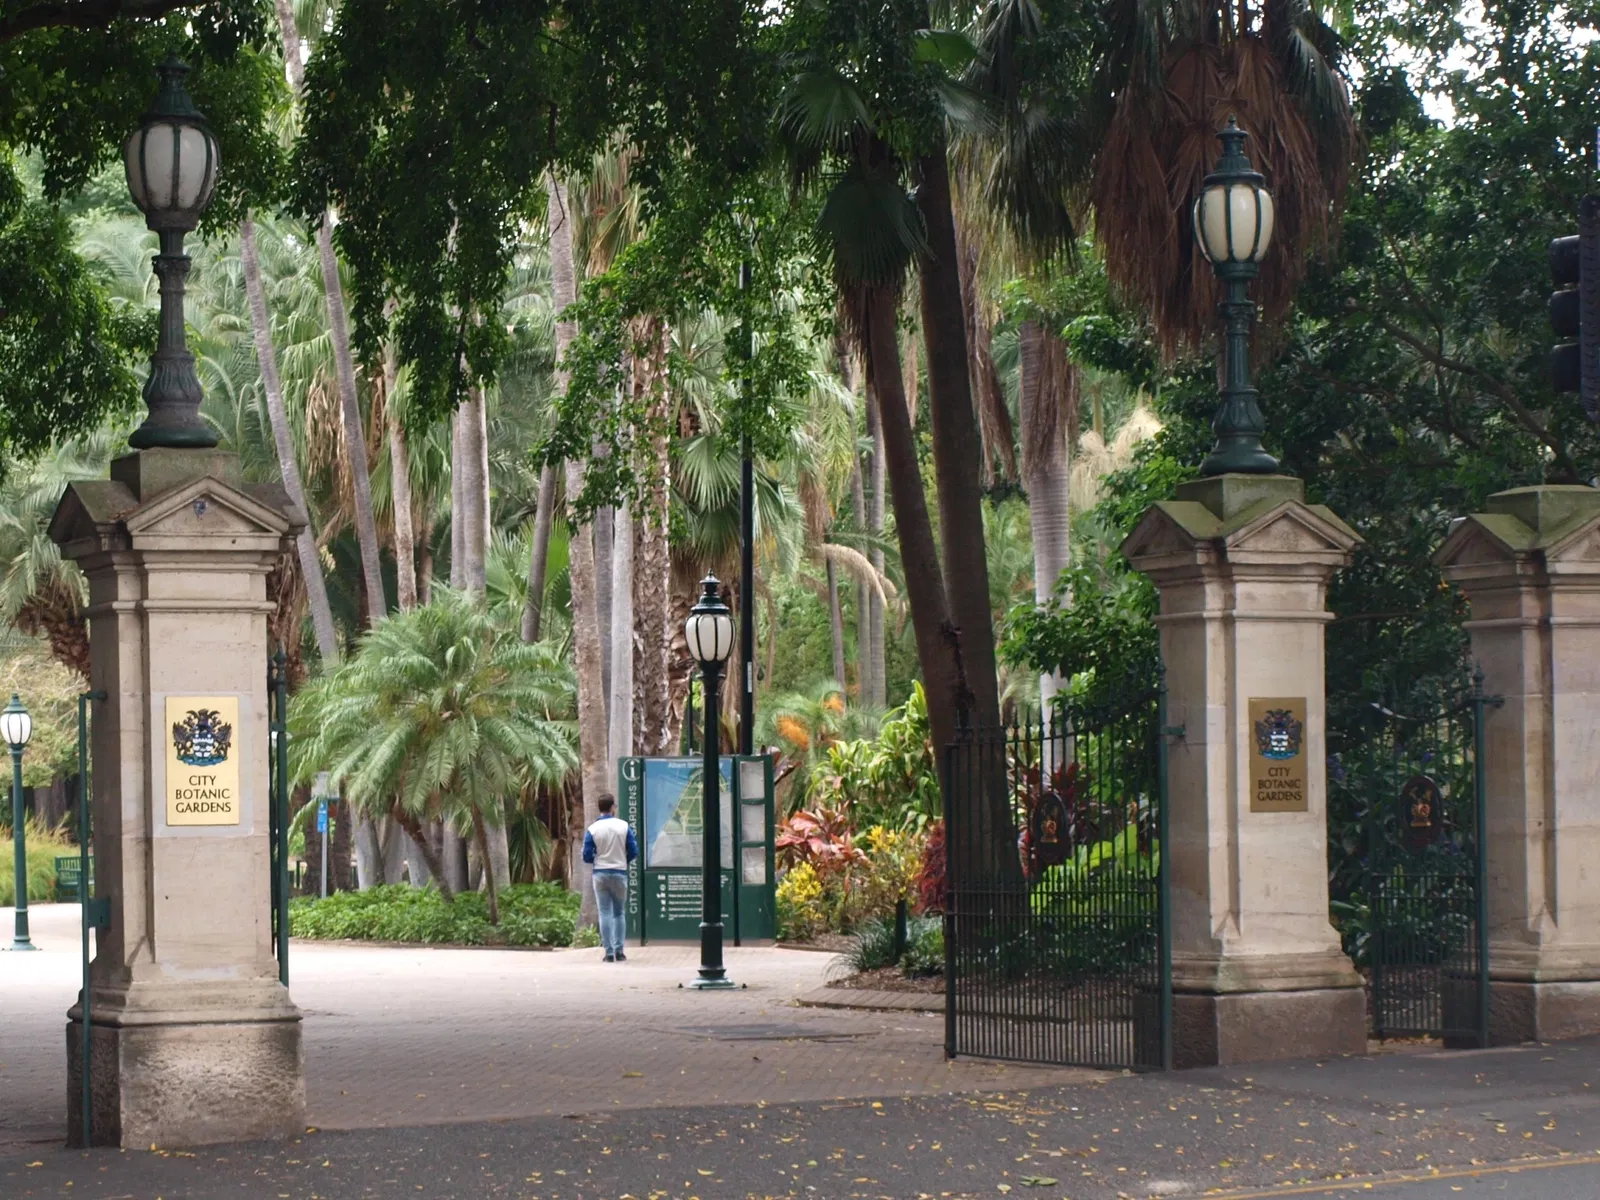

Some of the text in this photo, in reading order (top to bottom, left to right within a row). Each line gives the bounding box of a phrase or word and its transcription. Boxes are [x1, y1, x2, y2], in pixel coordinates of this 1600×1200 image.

[1267, 767, 1292, 777] CITY
[188, 775, 217, 786] CITY
[1258, 779, 1302, 789] BOTANIC
[175, 788, 231, 800] BOTANIC
[1257, 791, 1303, 801] GARDENS
[175, 802, 232, 813] GARDENS
[629, 889, 638, 914] CITY
